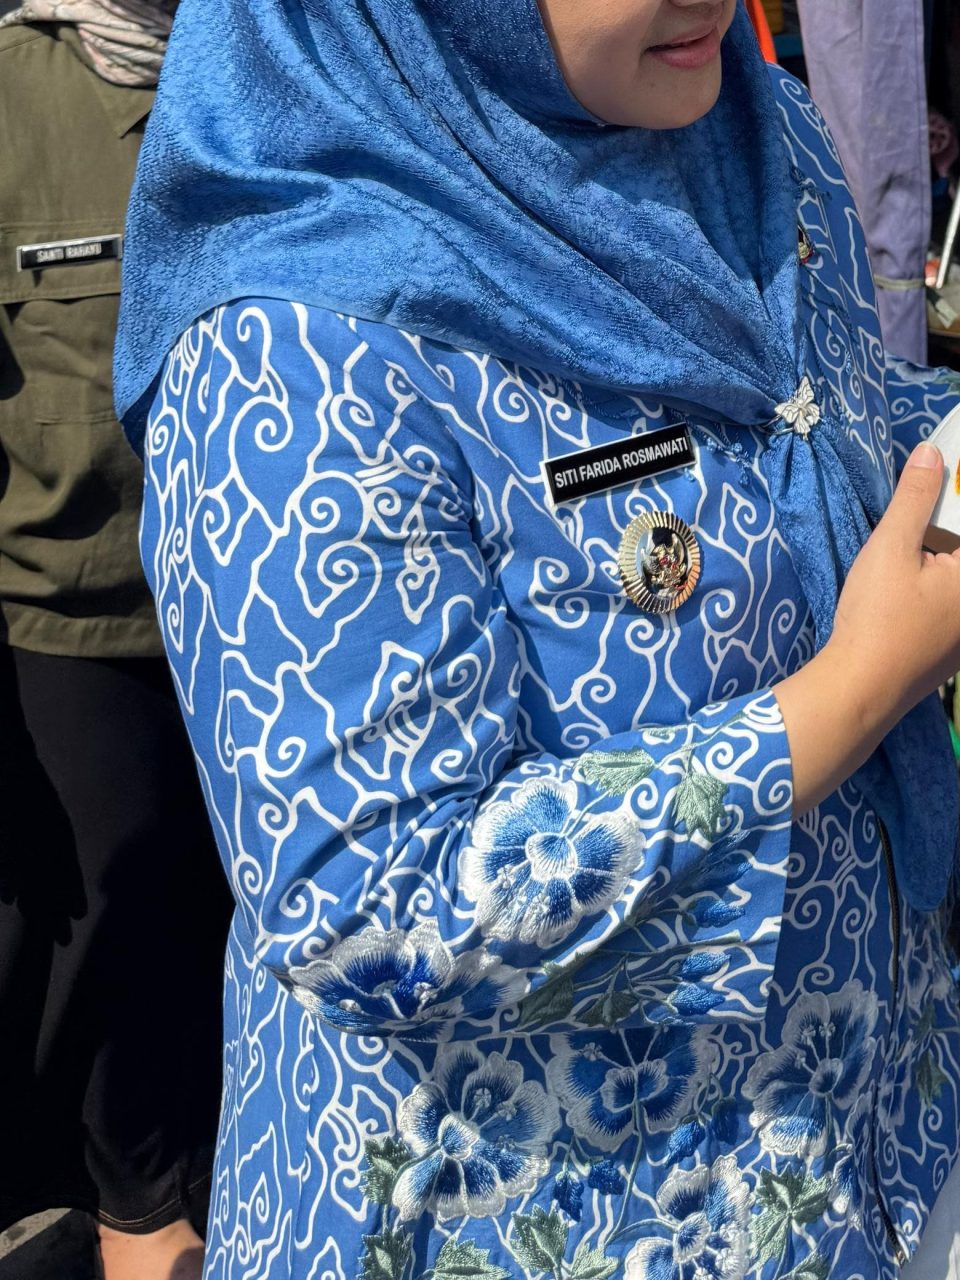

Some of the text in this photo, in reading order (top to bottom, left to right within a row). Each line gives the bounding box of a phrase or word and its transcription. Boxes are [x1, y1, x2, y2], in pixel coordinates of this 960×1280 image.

[554, 437, 689, 488] SITI FARIDA ROSMAWATI
